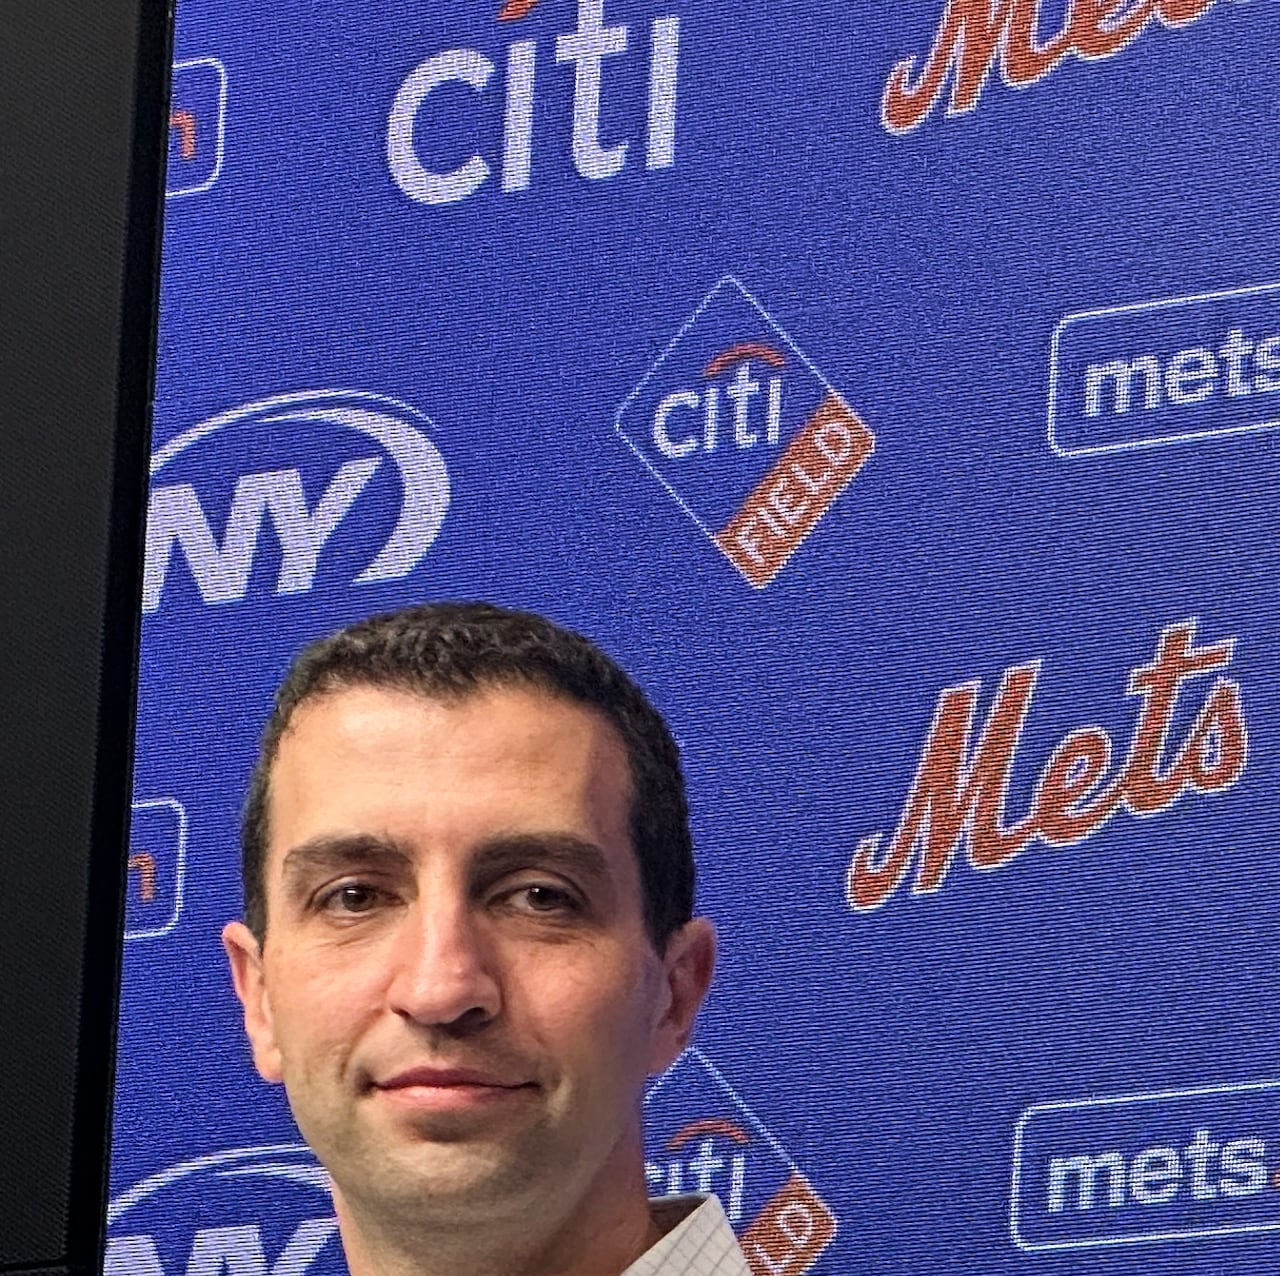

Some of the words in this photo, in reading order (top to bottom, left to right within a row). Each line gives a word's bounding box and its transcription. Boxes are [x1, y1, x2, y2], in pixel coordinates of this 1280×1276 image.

[387, 0, 680, 205] citi
[652, 362, 781, 459] citi
[141, 456, 383, 614] NY
[735, 422, 852, 566] FIELD
[846, 618, 1250, 911] Mets
